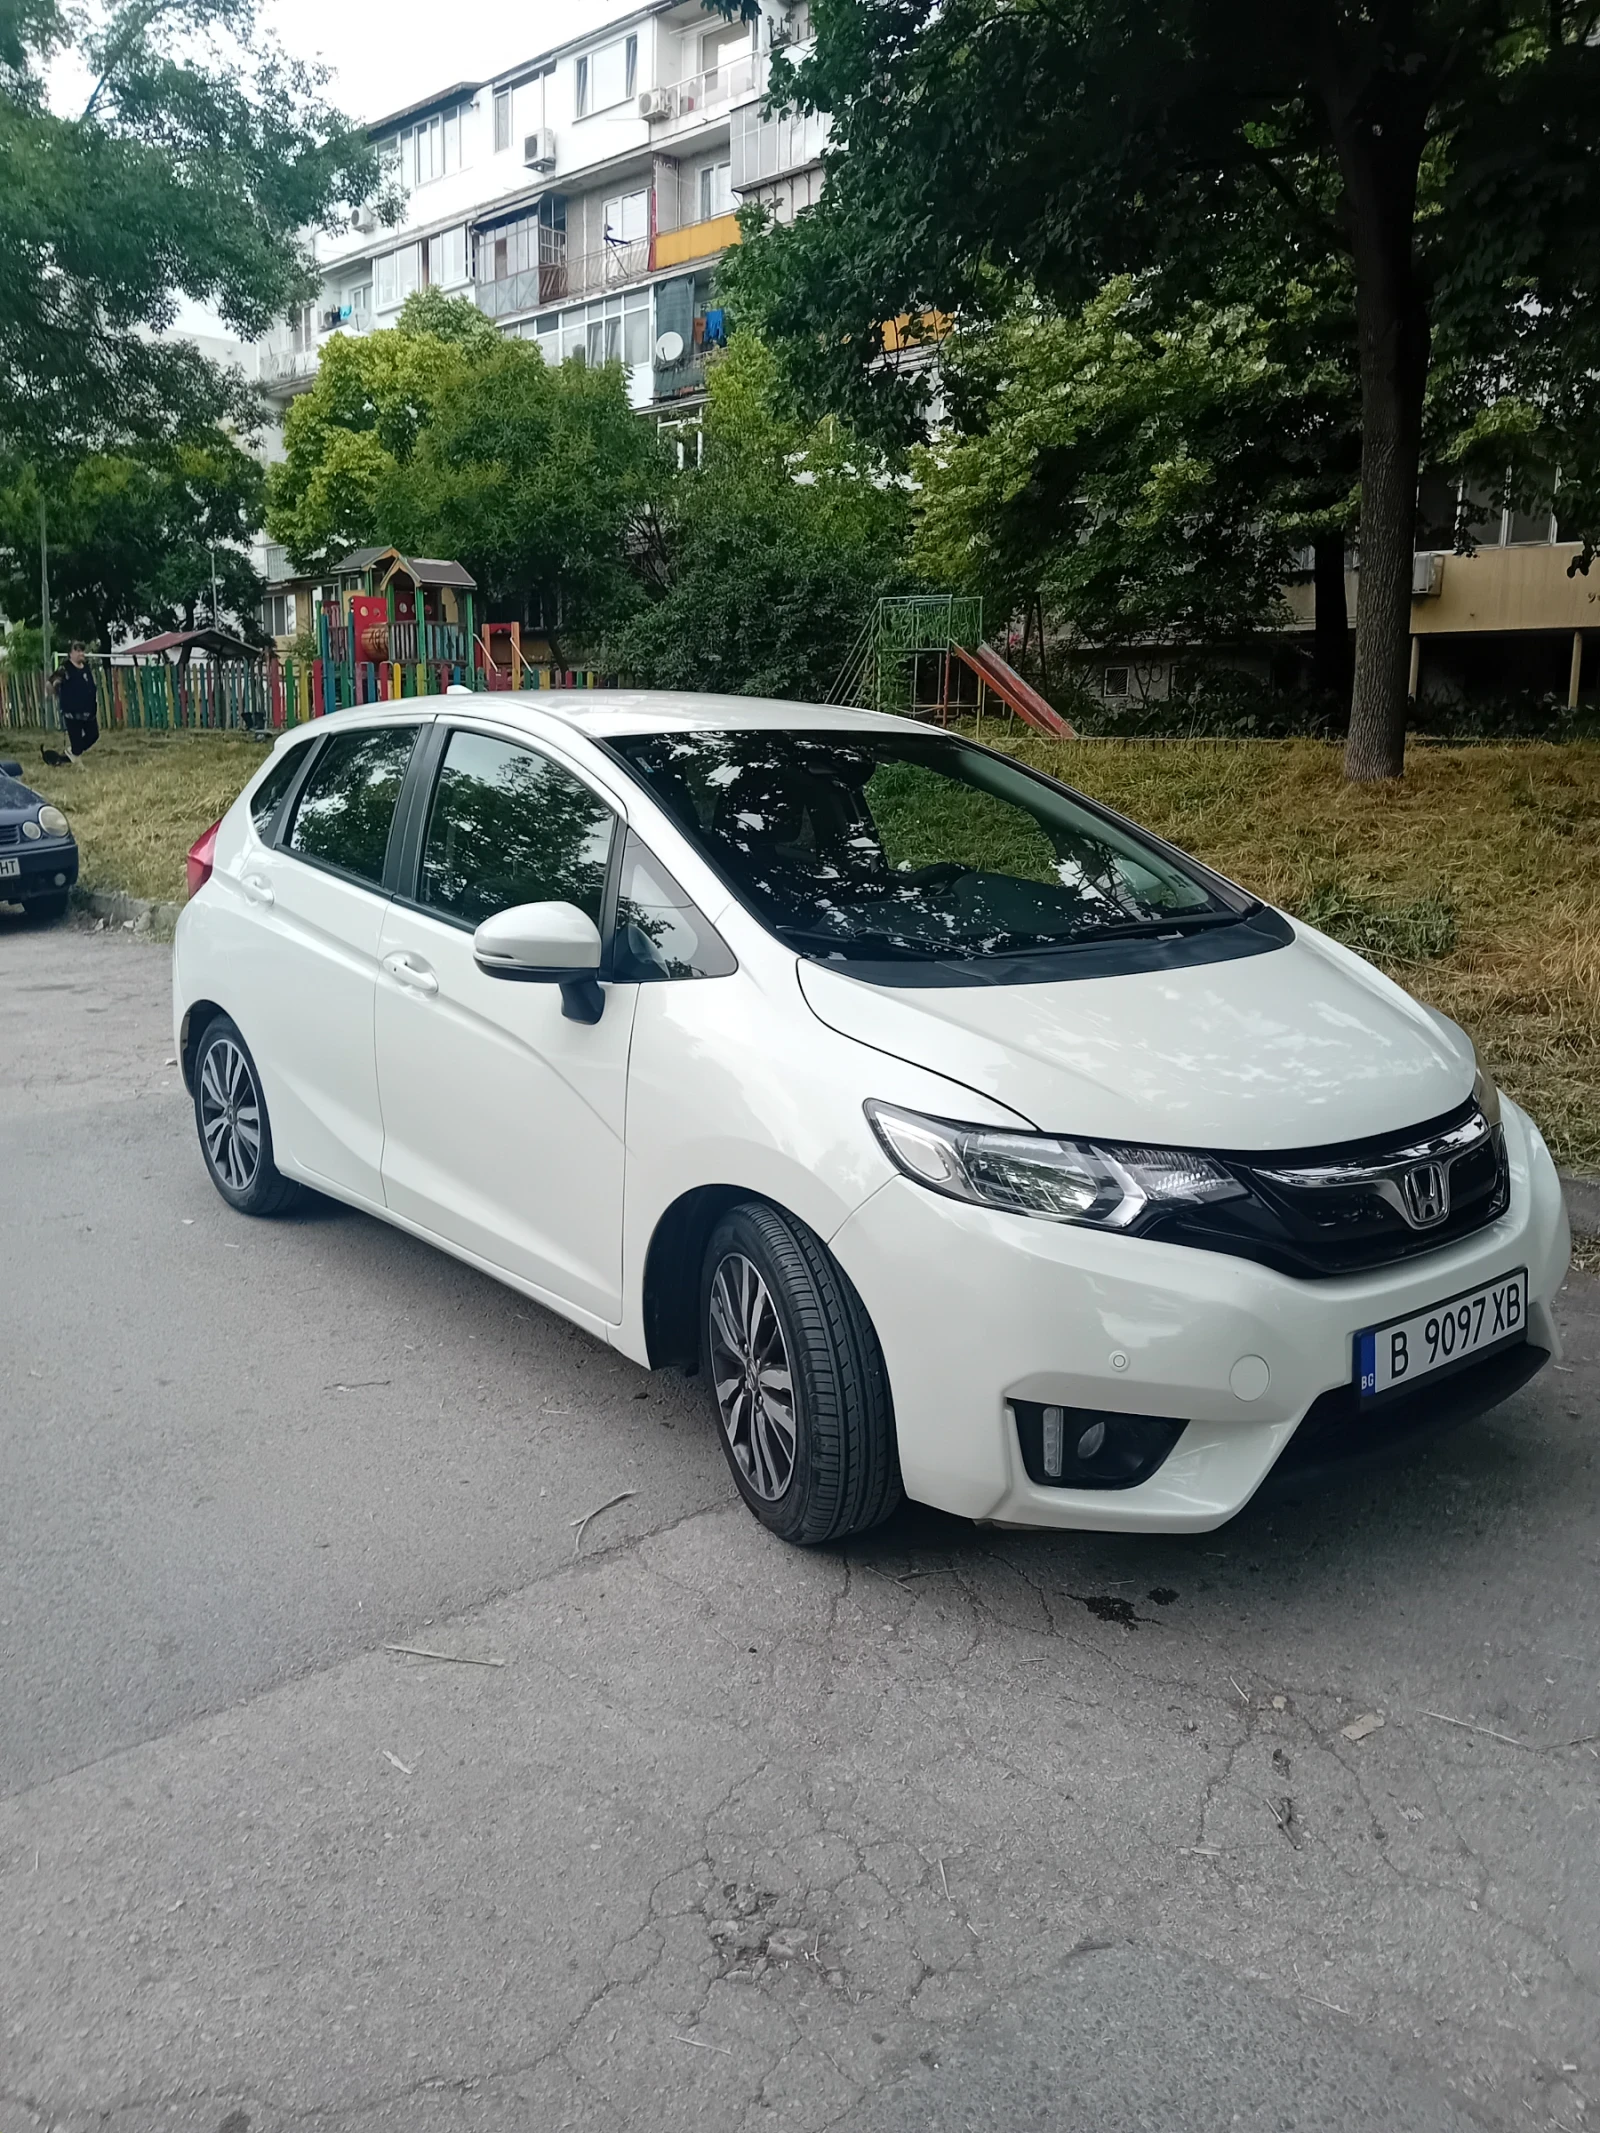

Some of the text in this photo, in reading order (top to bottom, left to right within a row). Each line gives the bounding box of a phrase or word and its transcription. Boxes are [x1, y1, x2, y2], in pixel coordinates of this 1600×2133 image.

[1390, 1282, 1521, 1380] B 9097 XB
[1361, 1372, 1374, 1390] BG
